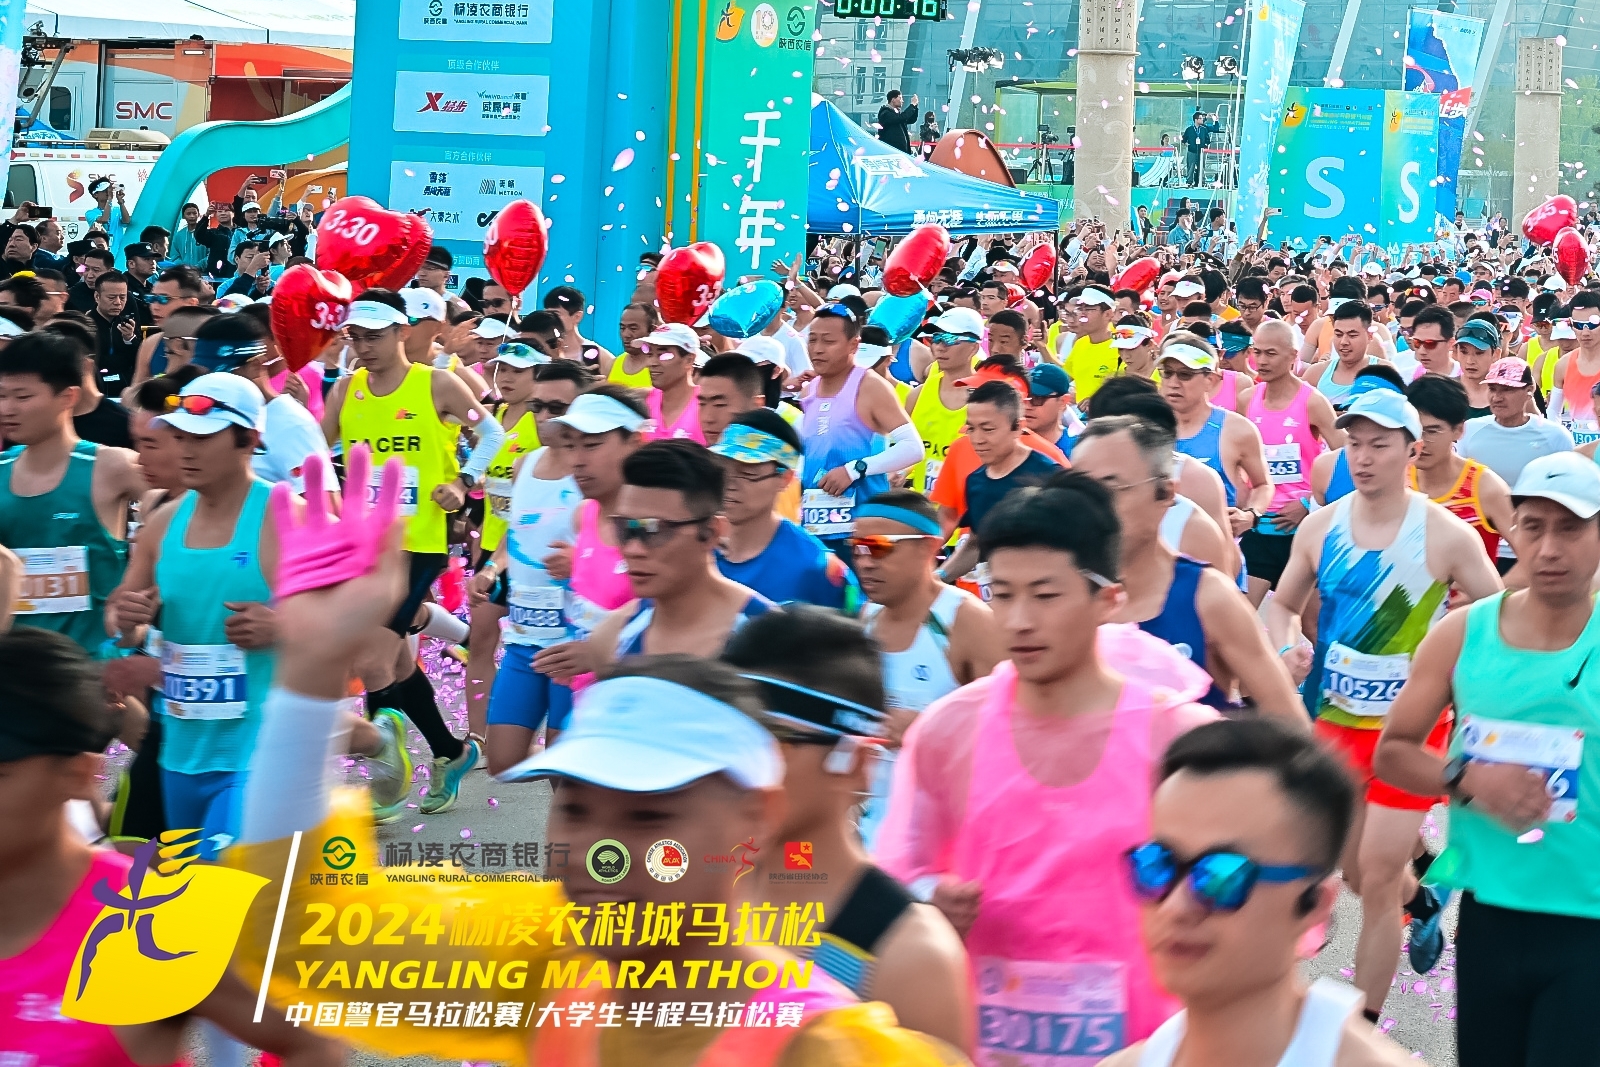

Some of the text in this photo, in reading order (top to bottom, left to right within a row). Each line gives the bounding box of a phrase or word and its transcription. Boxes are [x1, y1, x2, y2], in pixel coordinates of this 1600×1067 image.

[453, 2, 529, 18] 杨凌农商银行
[778, 37, 812, 51] 陕西农信
[447, 59, 500, 71] 顶级合作伙伴
[115, 101, 173, 121] SMC
[444, 150, 493, 162] 官方合作伙伴
[1303, 156, 1346, 219] S
[1397, 161, 1421, 224] S
[430, 210, 460, 224] 大秦之水
[324, 209, 381, 246] 3:30
[349, 435, 421, 453] ACER
[1329, 672, 1403, 701] 10526
